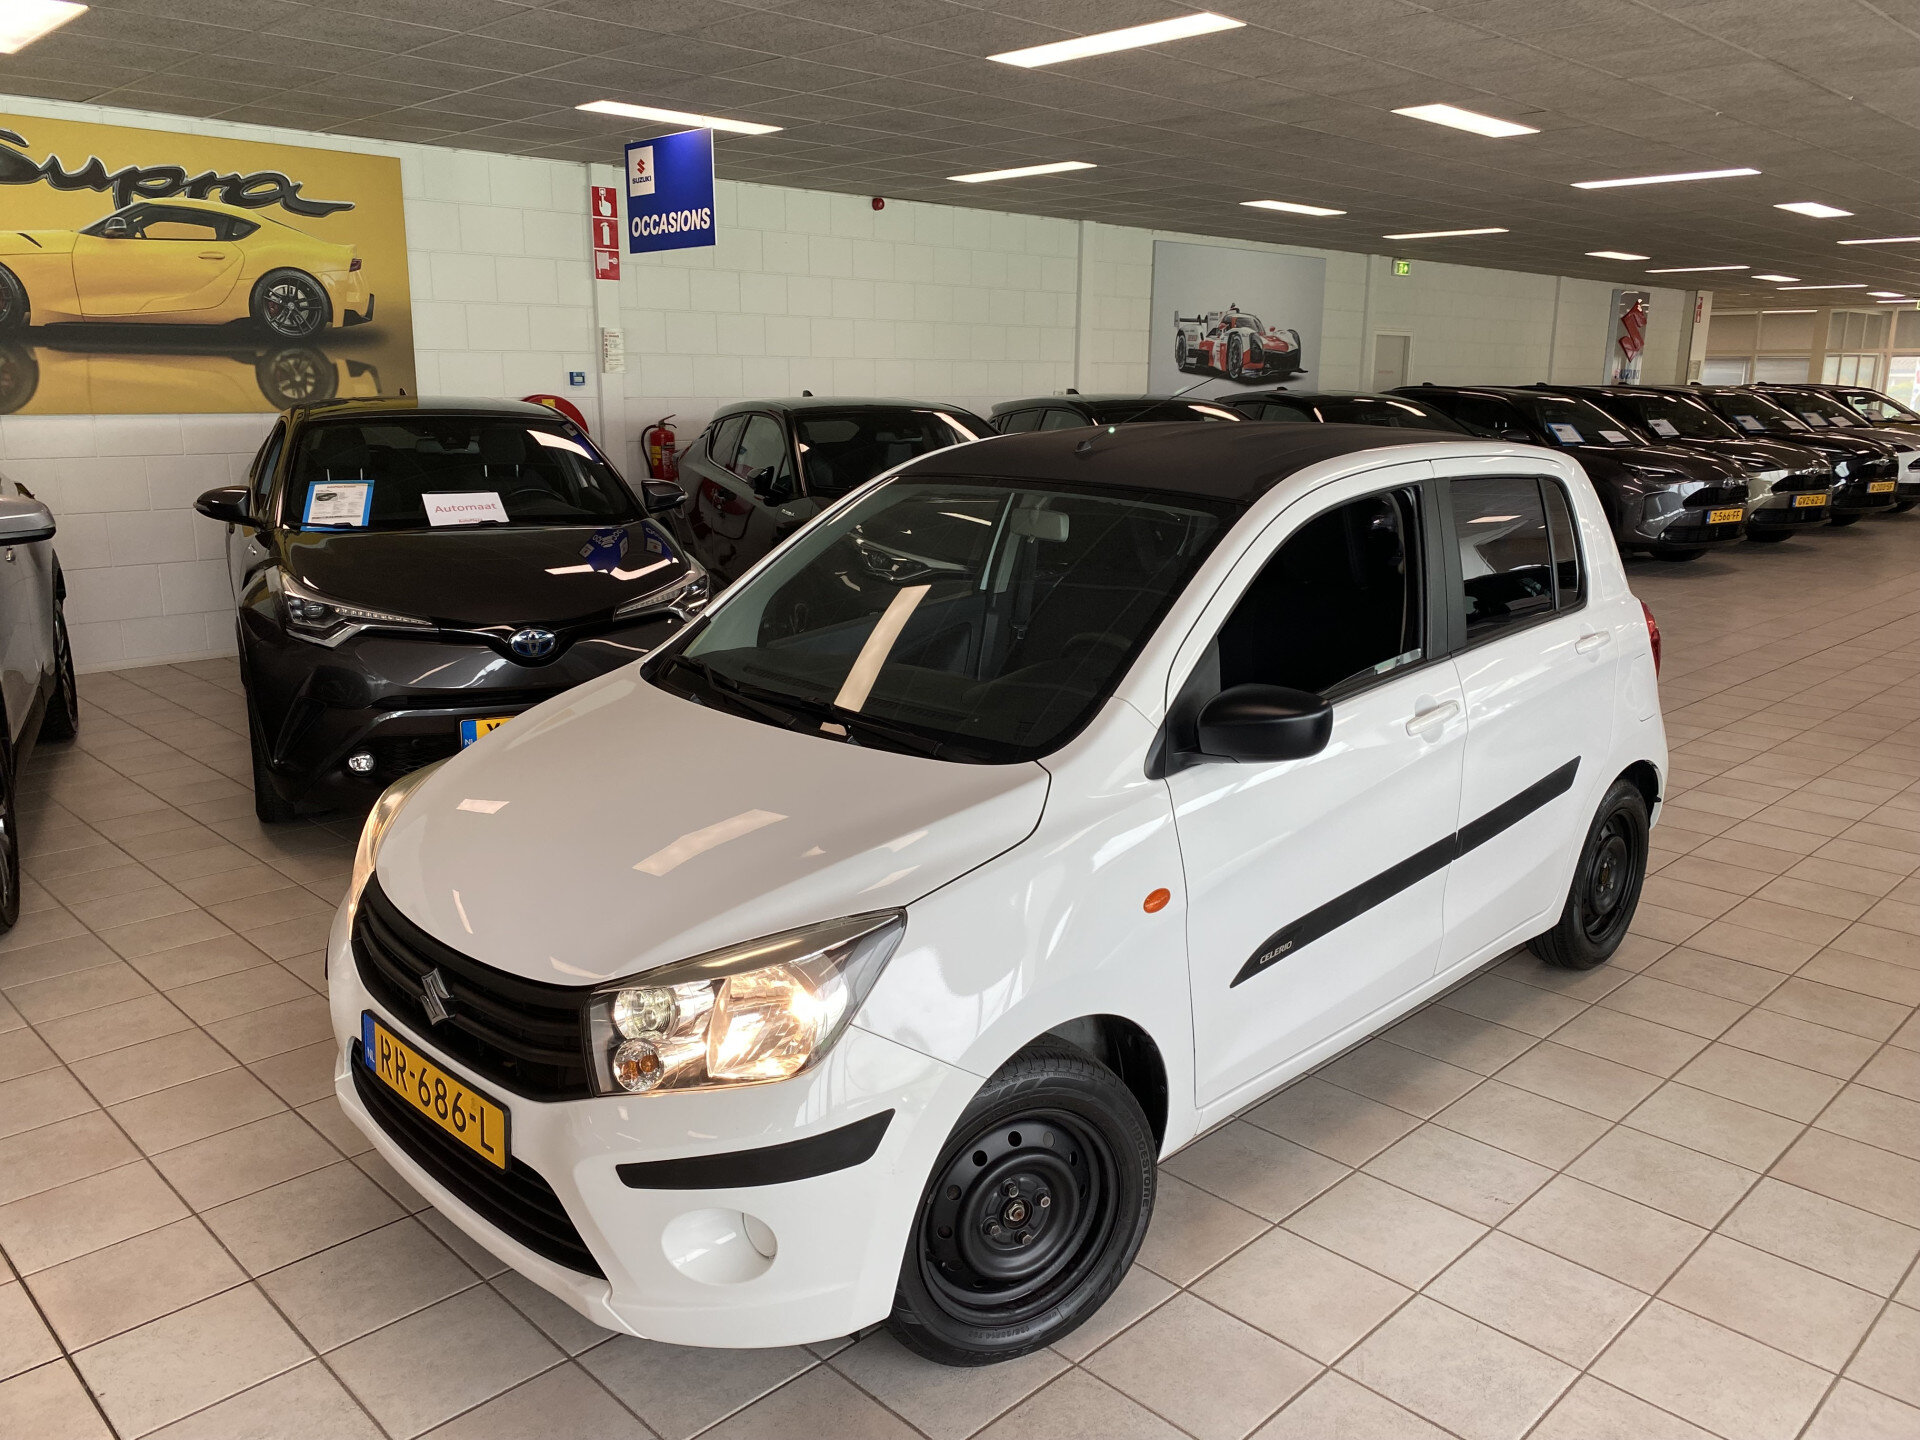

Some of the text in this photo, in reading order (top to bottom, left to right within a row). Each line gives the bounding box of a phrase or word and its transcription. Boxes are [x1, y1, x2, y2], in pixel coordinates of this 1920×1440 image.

[632, 175, 652, 185] SUZUKI
[631, 207, 711, 238] OCCASIONS
[435, 503, 497, 513] Automaat
[1712, 510, 1741, 522] Z-566-FF
[1260, 940, 1293, 964] CELERIO
[367, 1046, 375, 1063] NL
[380, 1035, 495, 1155] RR-686-L
